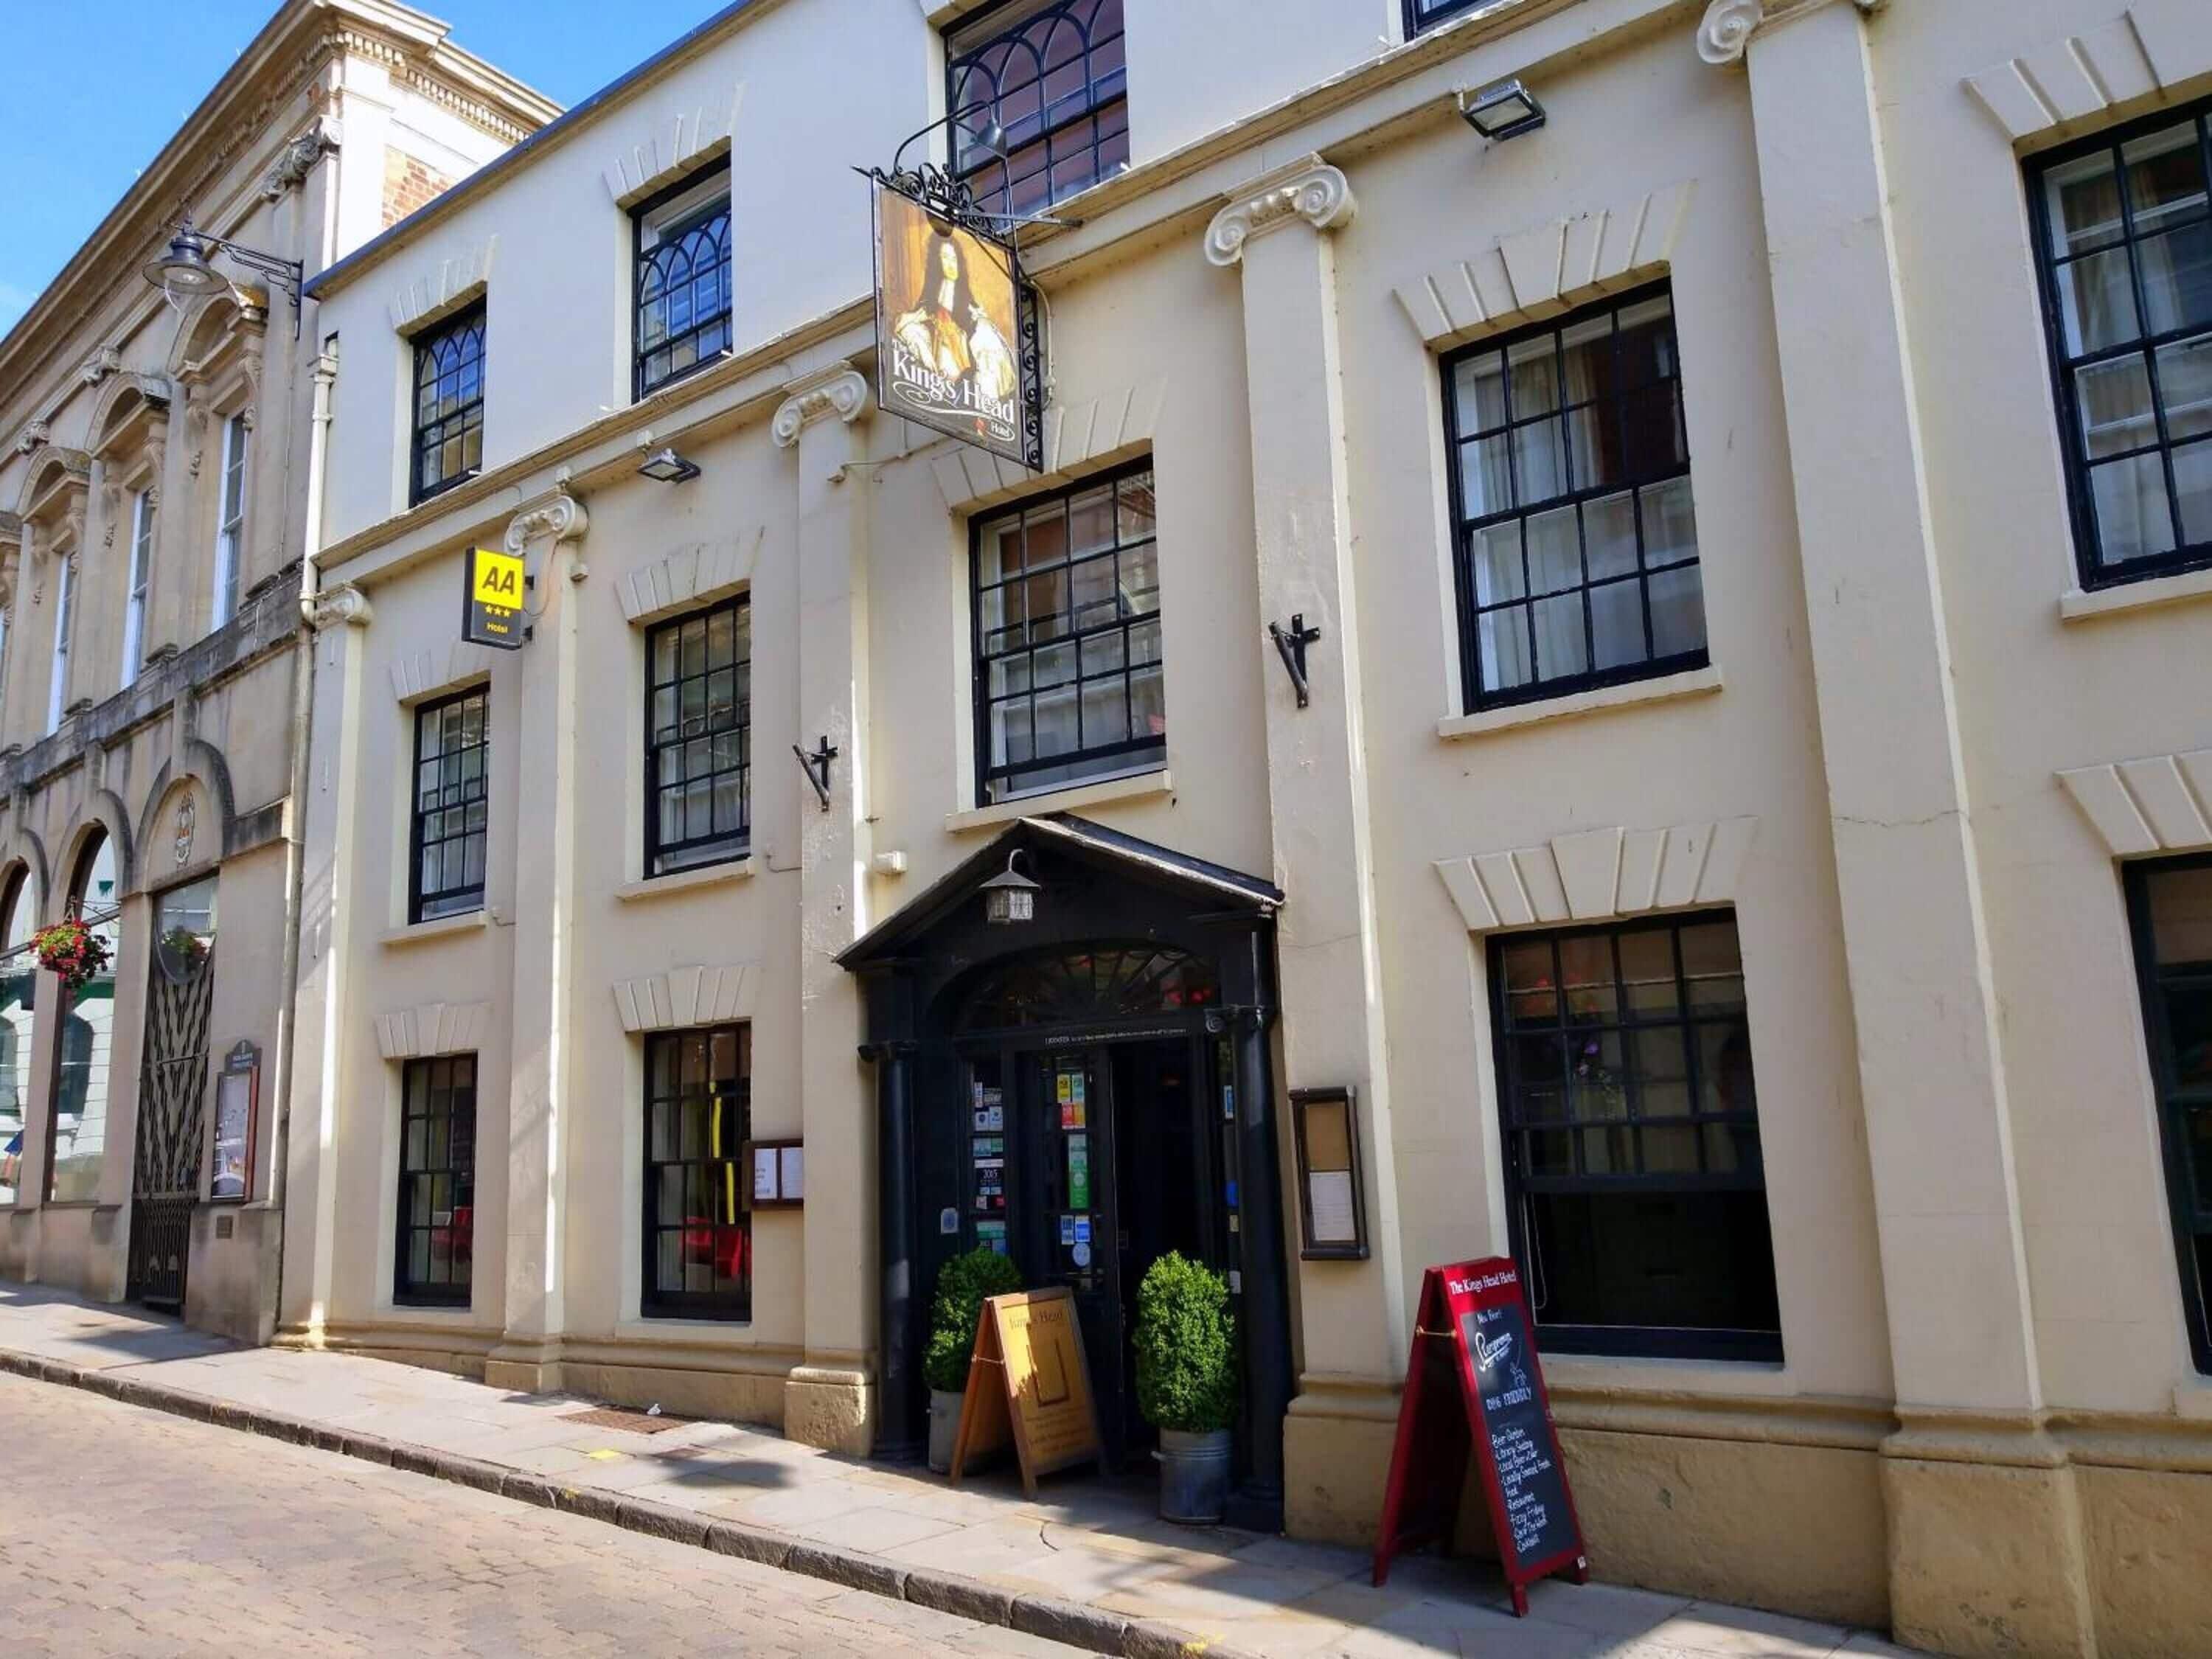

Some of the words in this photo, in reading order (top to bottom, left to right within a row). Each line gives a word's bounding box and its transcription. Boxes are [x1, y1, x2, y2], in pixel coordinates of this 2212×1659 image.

[962, 378, 1015, 423] Head
[482, 566, 515, 596] AA
[1449, 1280, 1464, 1295] The
[1463, 1278, 1483, 1293] Kings
[1482, 1275, 1500, 1288] Head
[1499, 1270, 1517, 1284] Hotel
